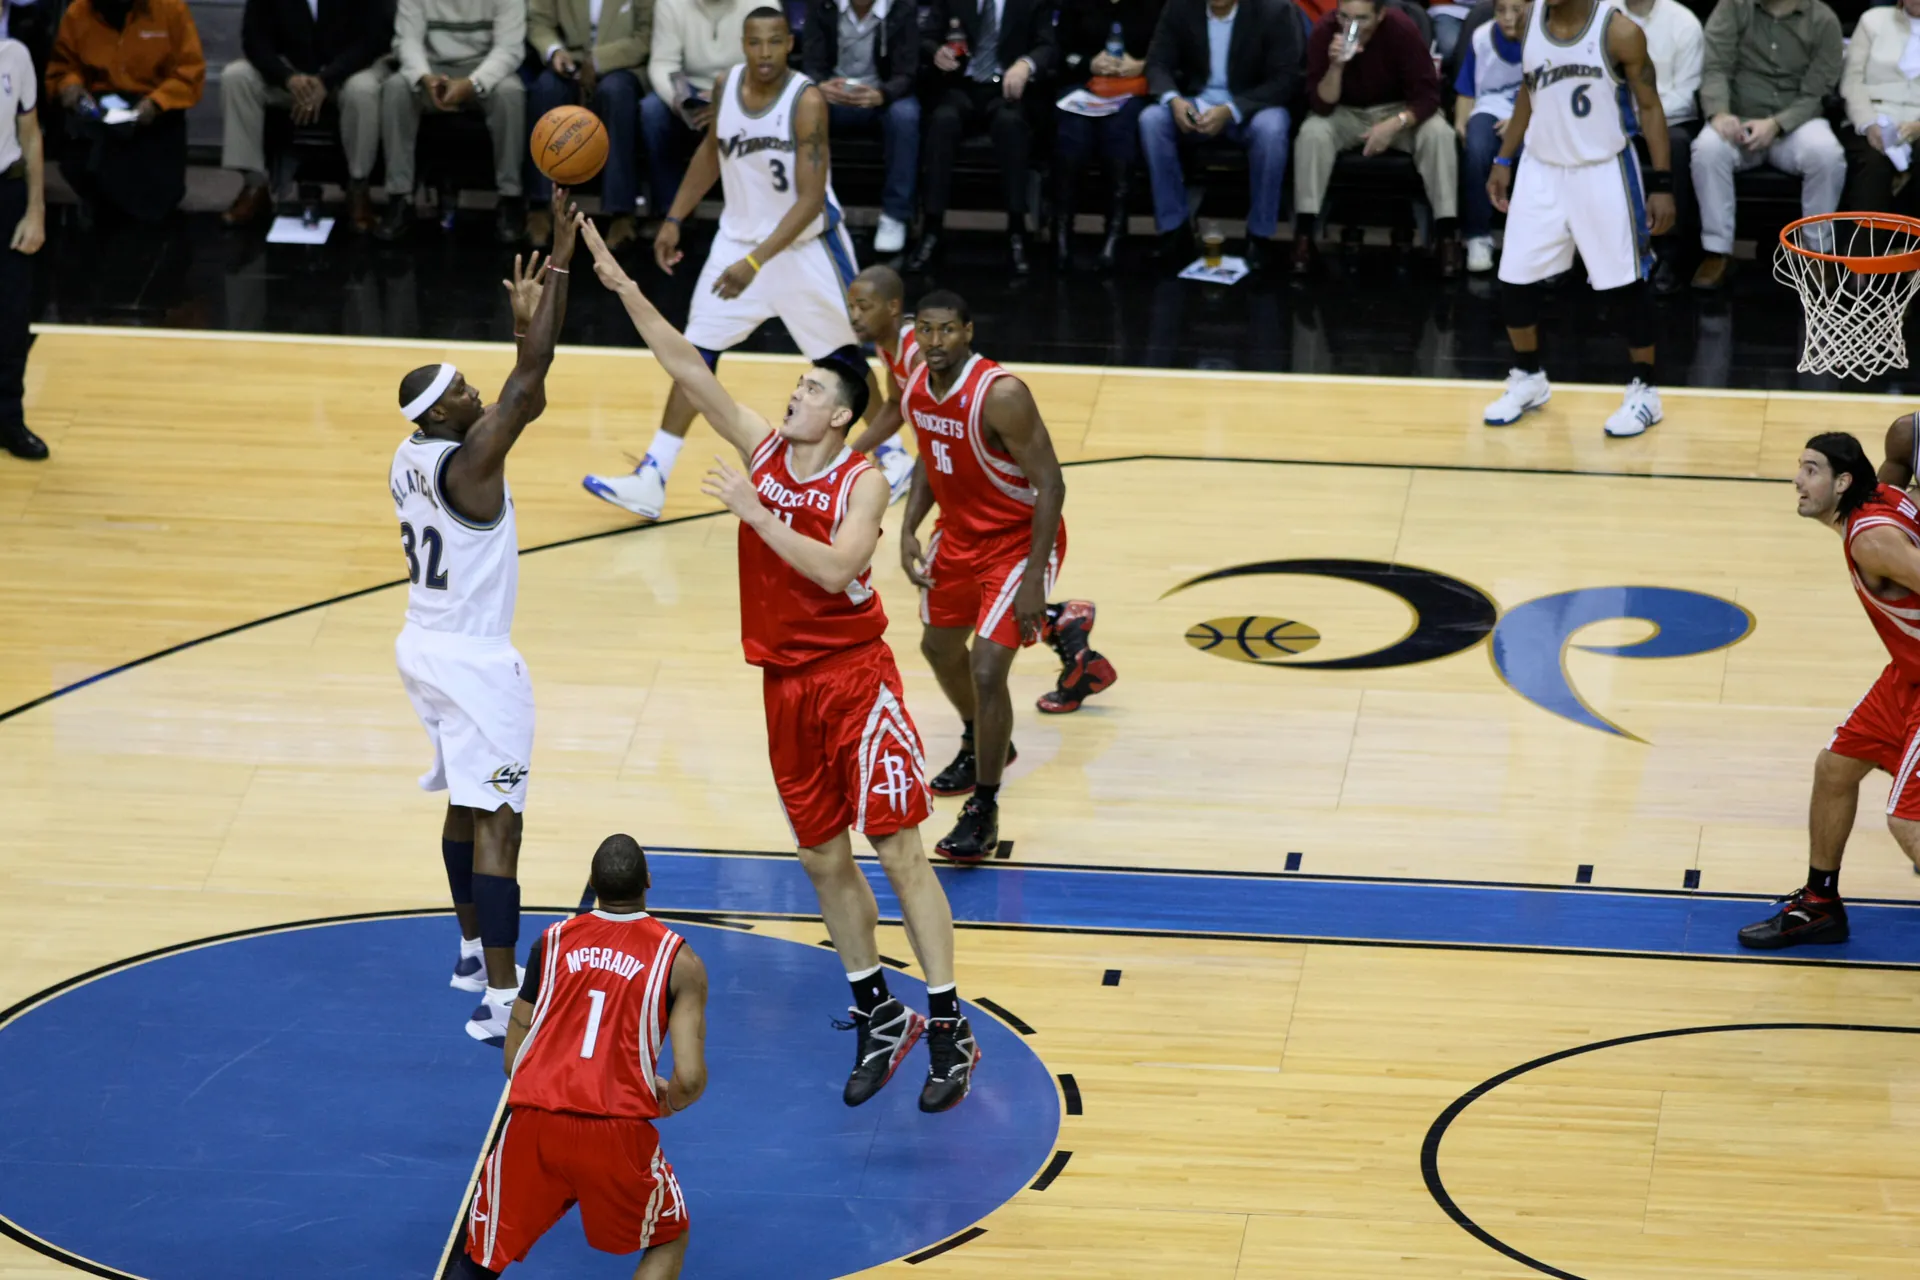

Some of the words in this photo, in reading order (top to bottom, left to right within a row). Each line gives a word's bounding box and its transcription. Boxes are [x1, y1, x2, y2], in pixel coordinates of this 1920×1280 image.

[1571, 84, 1592, 118] 6
[769, 159, 789, 193] 3
[912, 409, 964, 440] ROCKETS
[931, 440, 954, 475] 96
[757, 472, 831, 512] ROCKETS
[400, 521, 448, 590] 32
[580, 989, 606, 1060] 1
